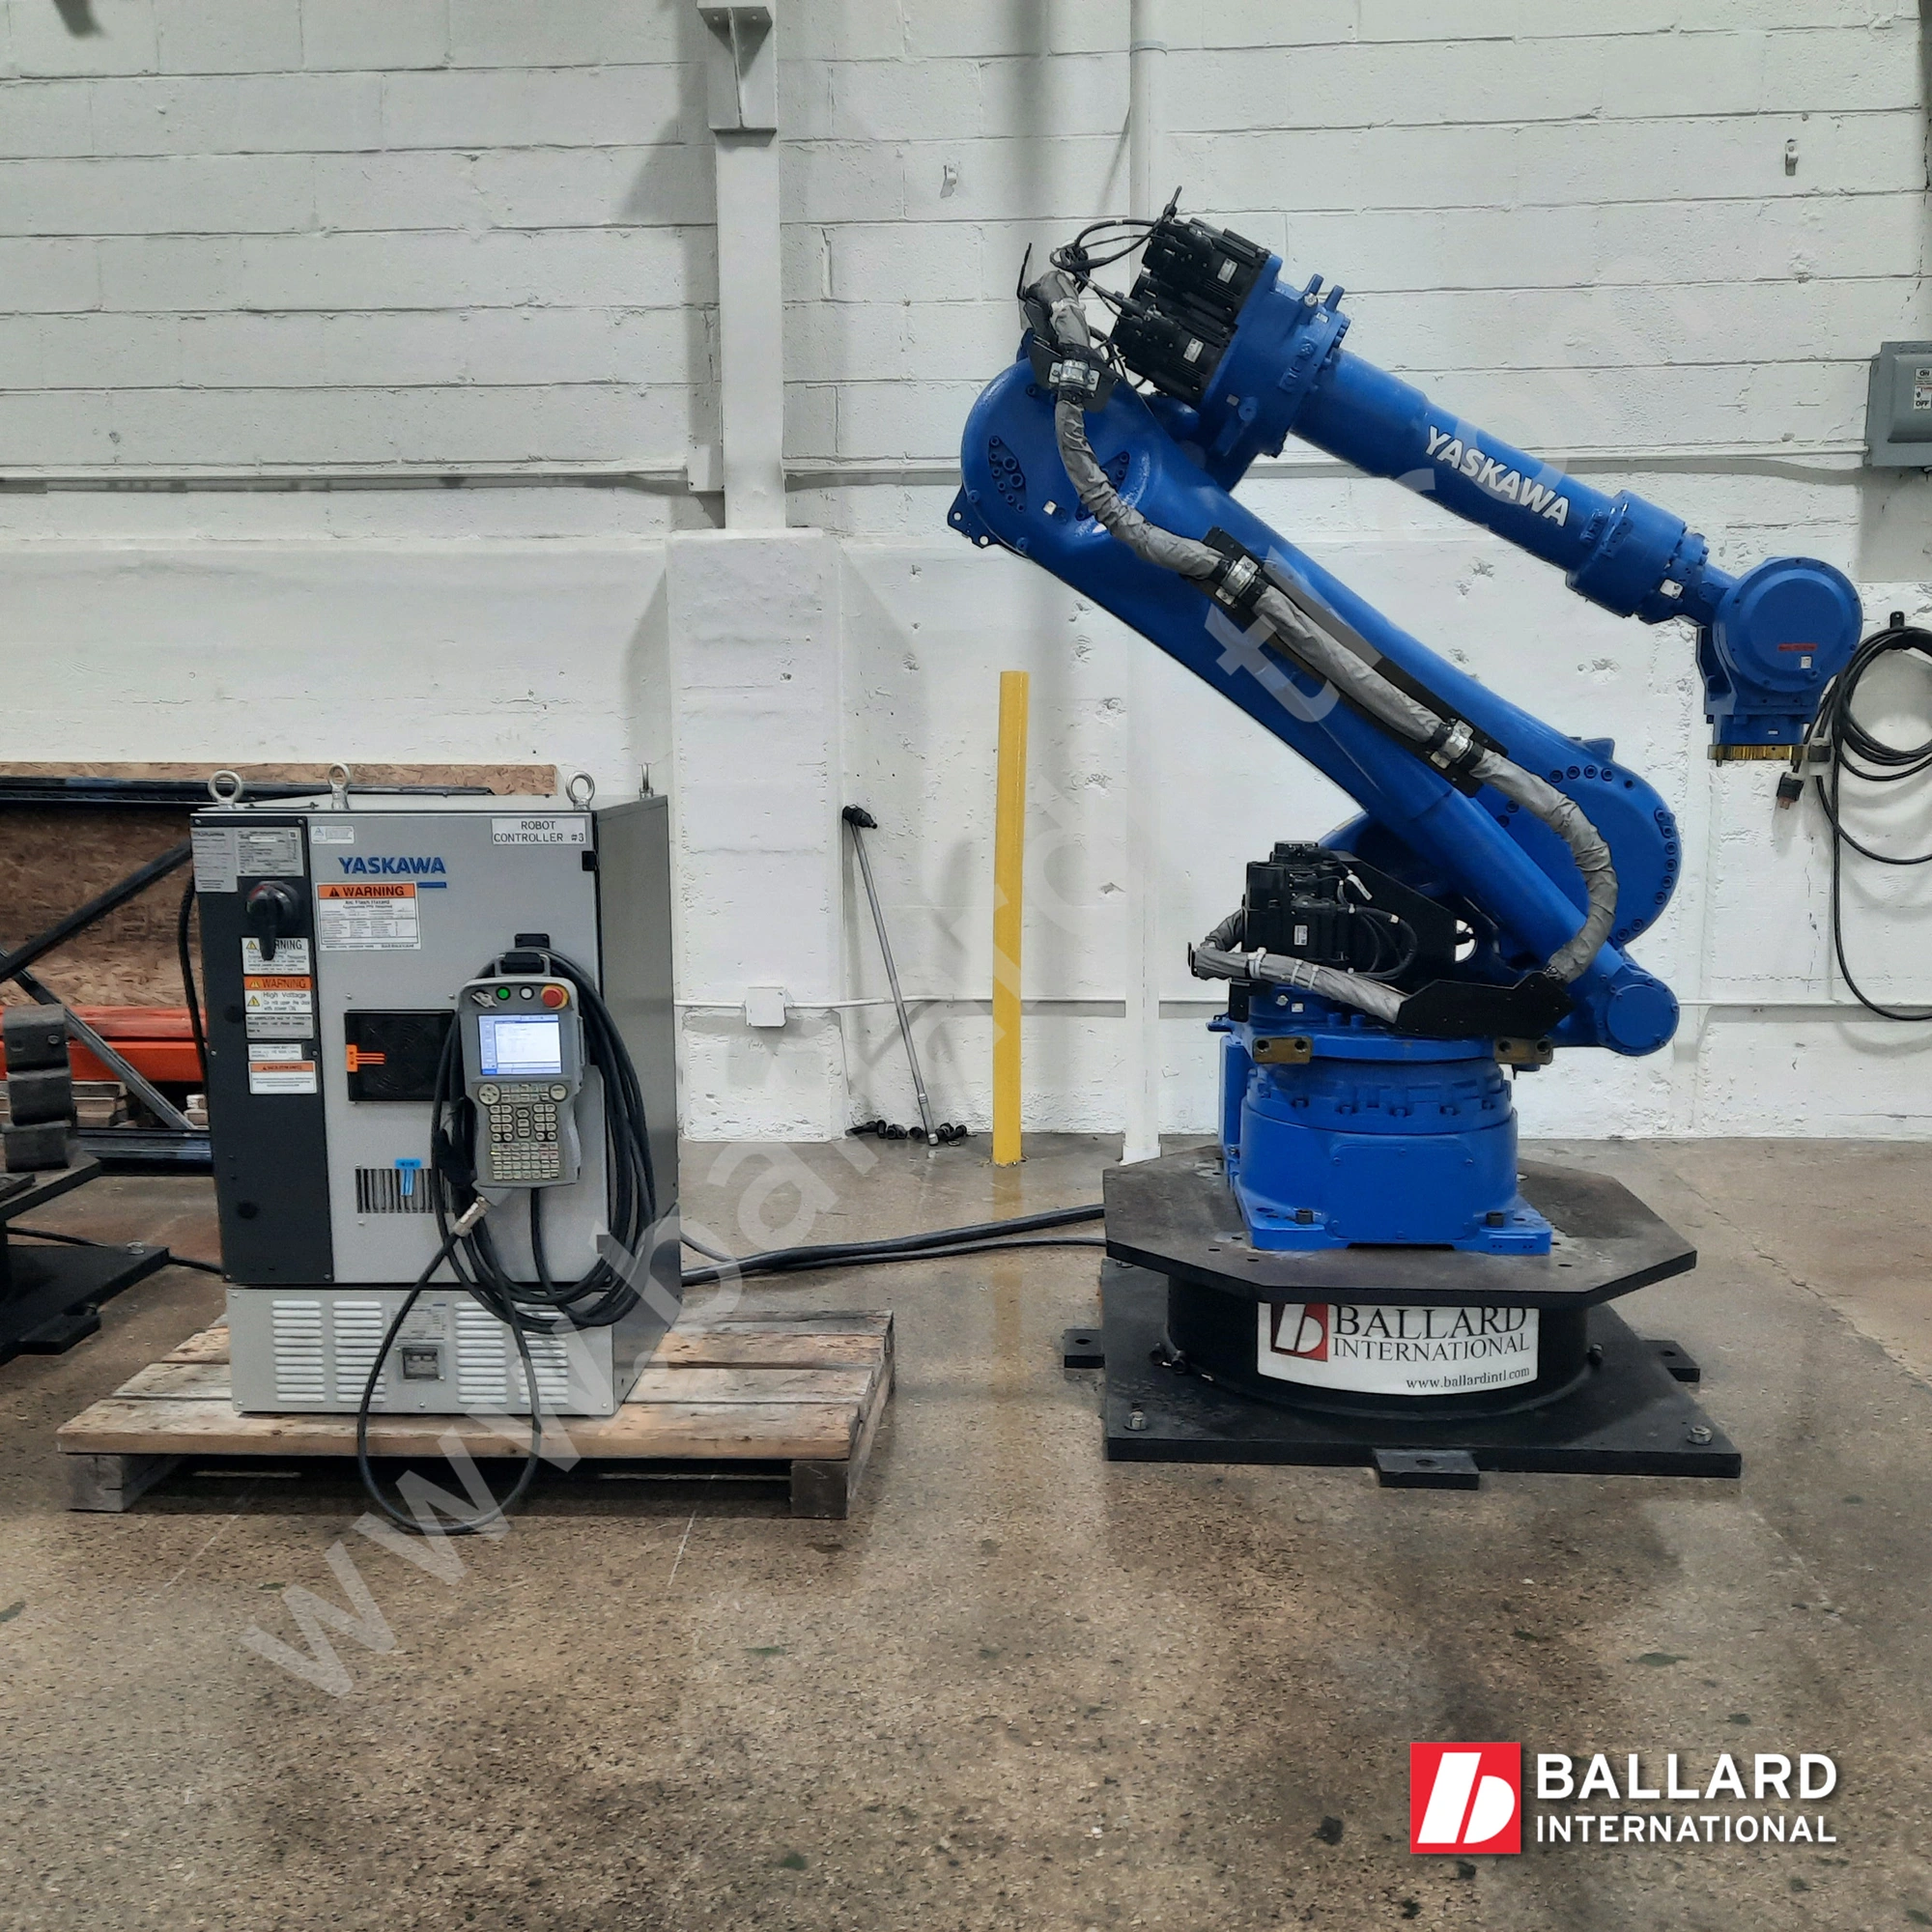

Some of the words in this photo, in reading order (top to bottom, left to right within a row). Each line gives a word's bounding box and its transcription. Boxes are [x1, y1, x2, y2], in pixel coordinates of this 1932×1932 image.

[1425, 425, 1570, 527] YASKAWA
[521, 820, 556, 831] ROBOT
[494, 833, 564, 843] CONTROLLER
[571, 833, 584, 842] #3
[338, 857, 446, 874] YASKAWA
[343, 886, 405, 897] WARNING
[262, 978, 306, 989] WARNING
[1333, 1304, 1527, 1340] BALLARD
[1333, 1333, 1530, 1362] INTERNATIONAL
[1406, 1366, 1530, 1389] www.ballardintl.com
